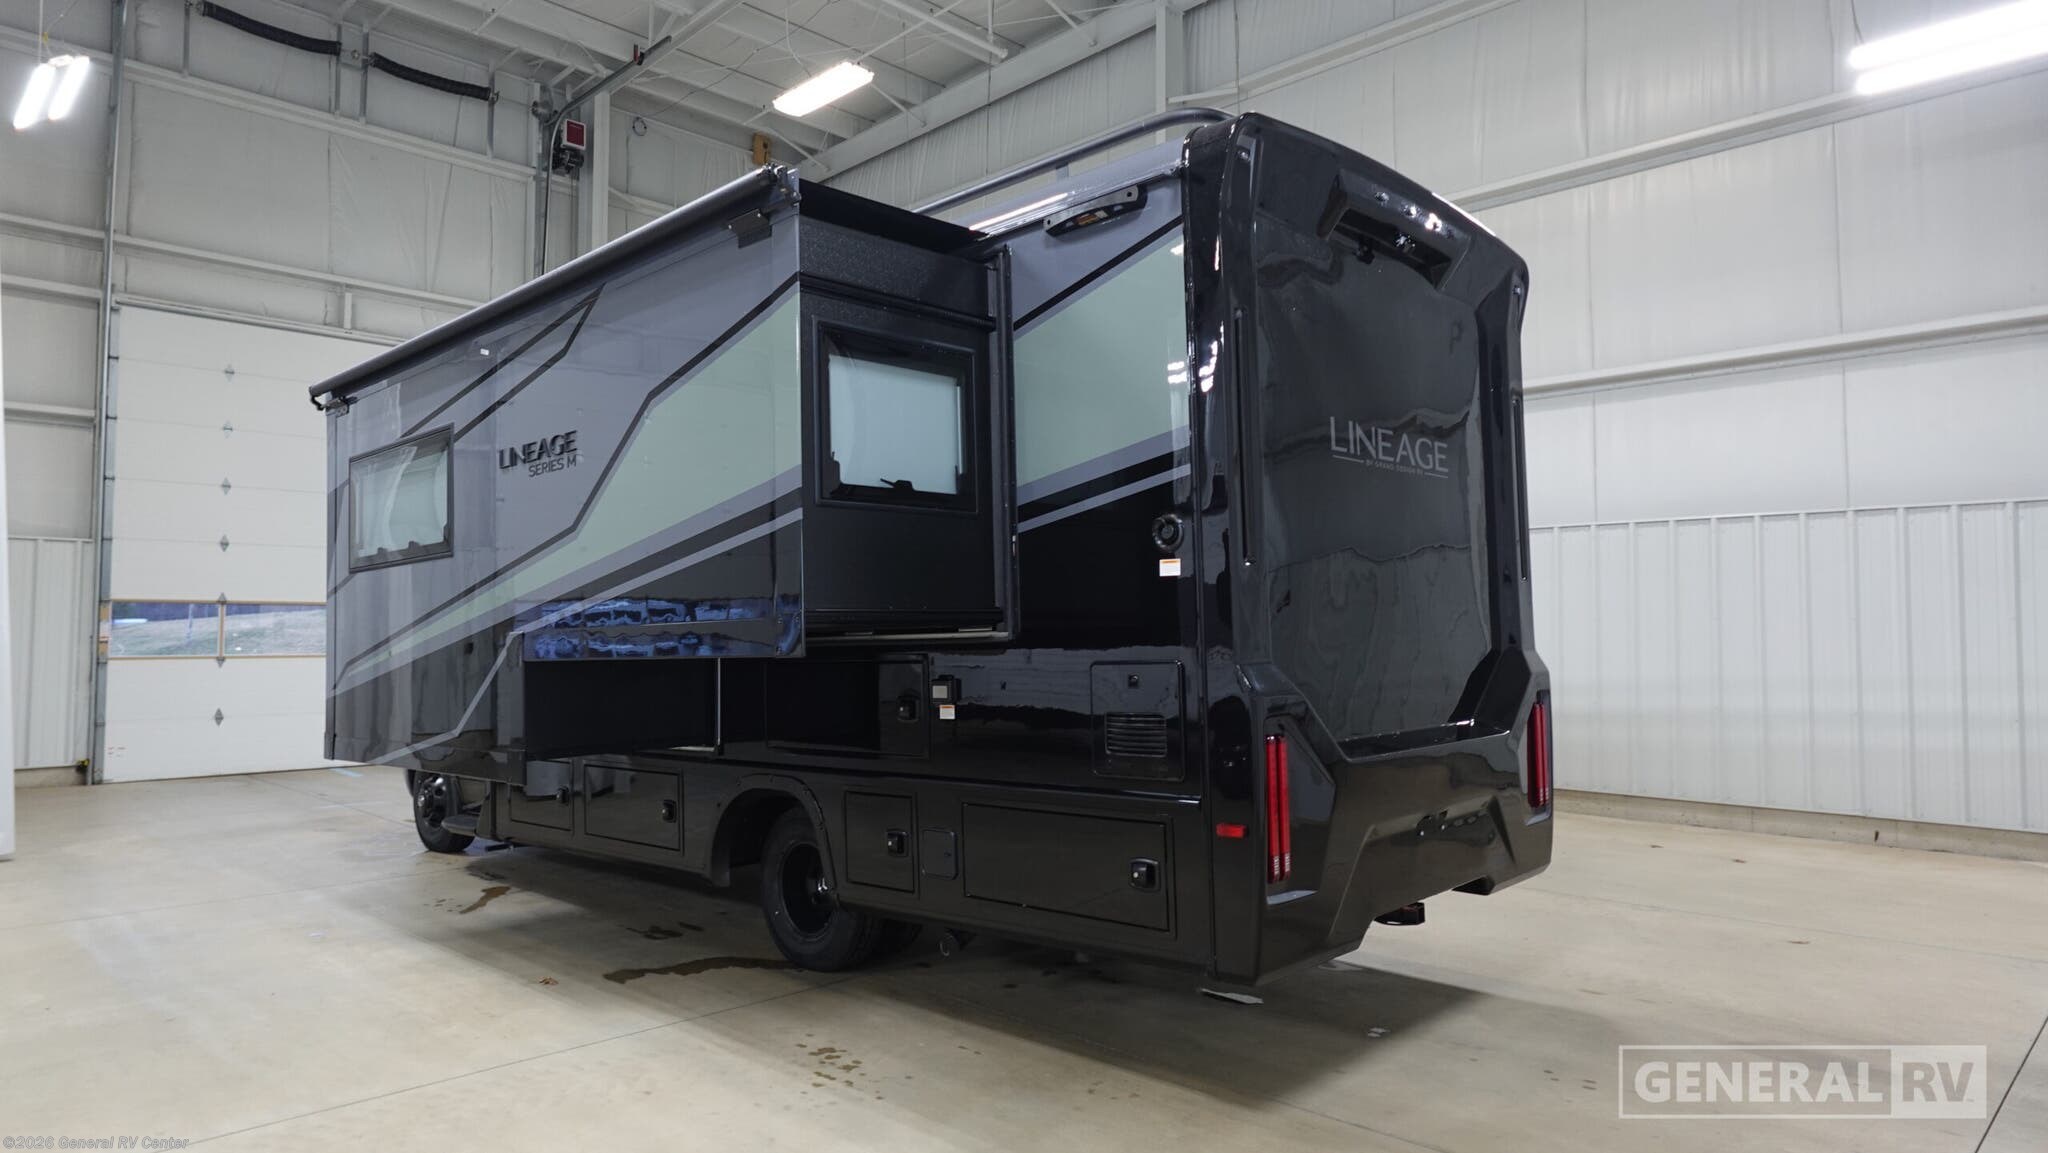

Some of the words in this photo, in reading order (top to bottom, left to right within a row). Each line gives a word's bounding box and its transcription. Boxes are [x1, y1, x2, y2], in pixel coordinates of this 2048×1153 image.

[499, 430, 577, 470] LINEAGE
[1330, 416, 1449, 473] LINEAGE
[528, 457, 565, 478] SERIES
[566, 454, 577, 469] M
